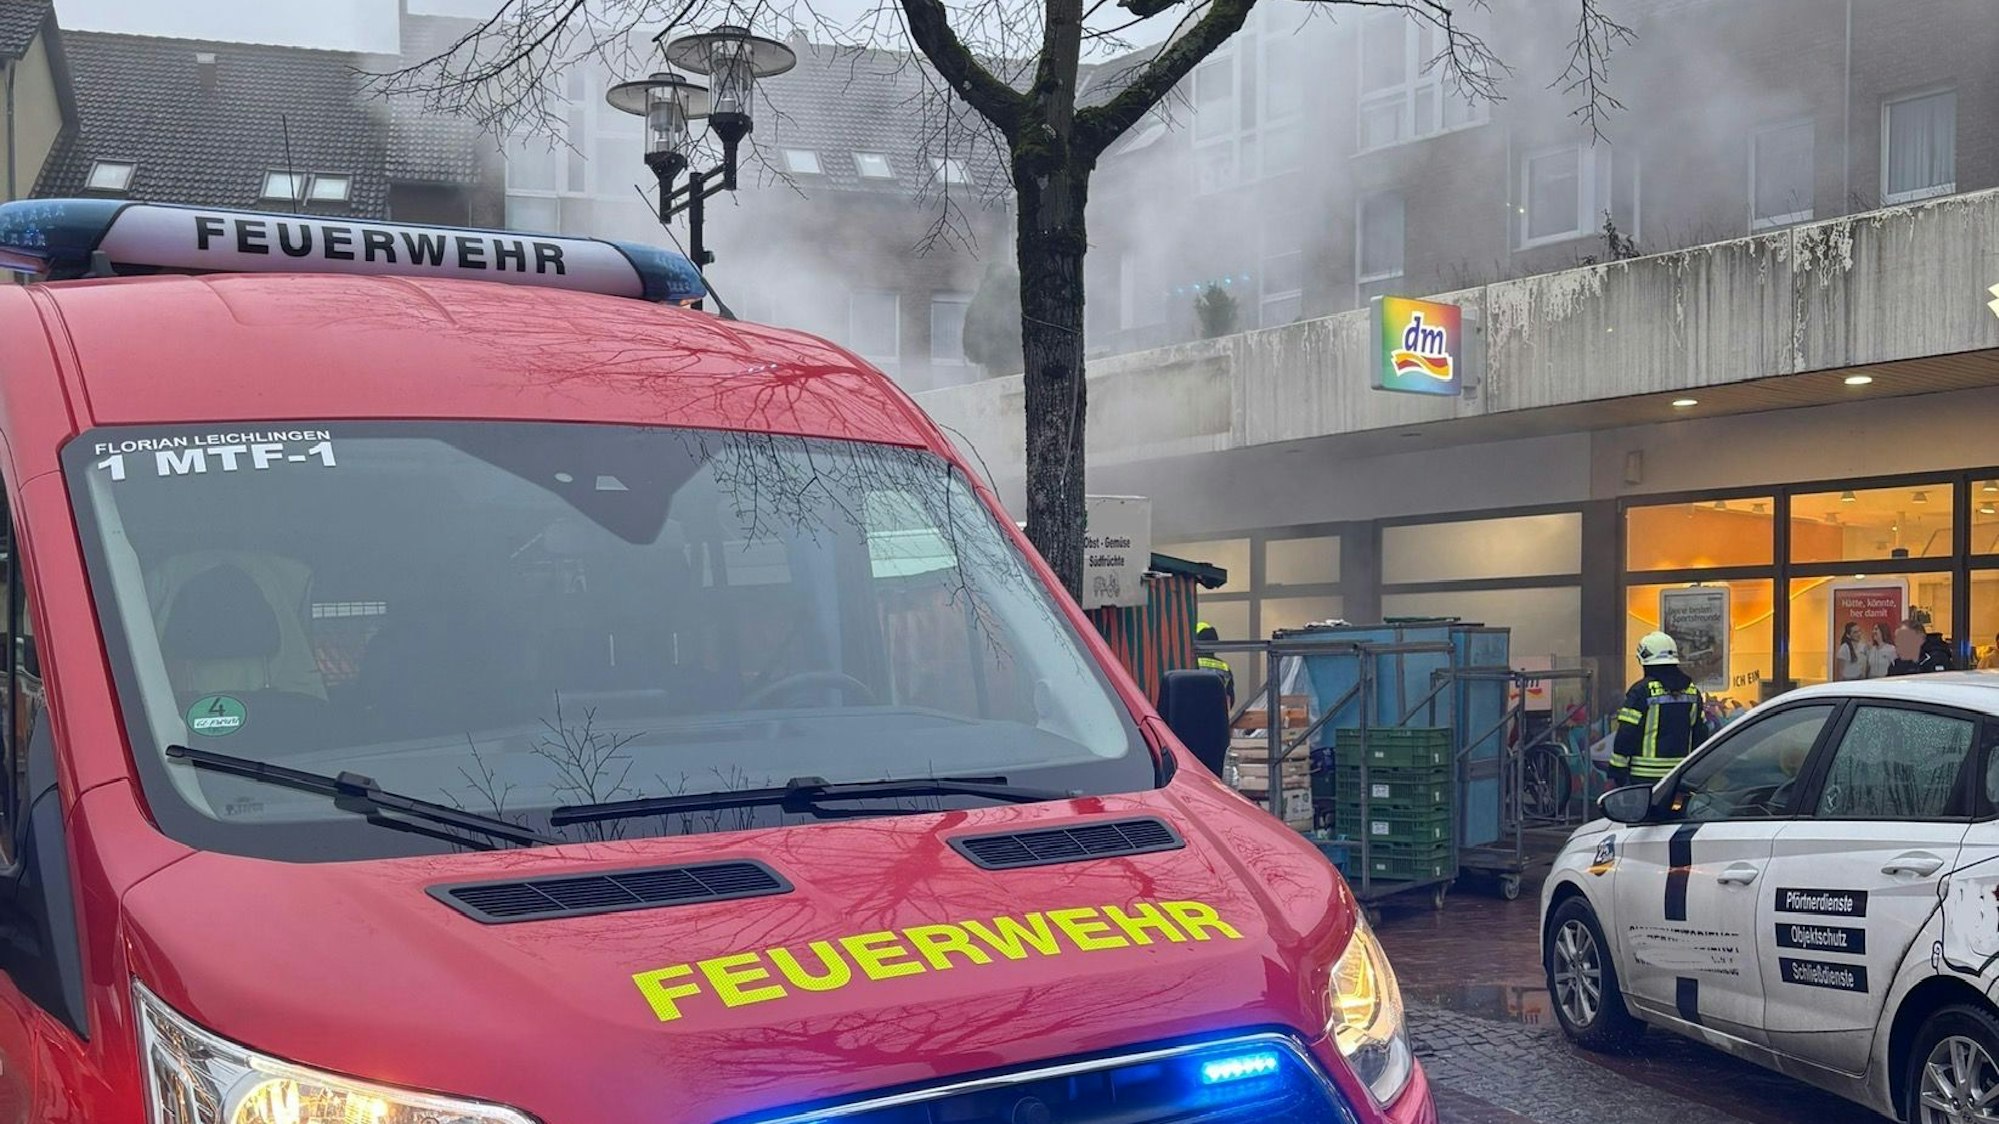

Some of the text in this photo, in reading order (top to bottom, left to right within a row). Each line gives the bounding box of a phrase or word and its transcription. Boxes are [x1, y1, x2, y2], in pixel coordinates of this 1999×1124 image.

[195, 216, 566, 275] FEUERWEHR
[1404, 315, 1444, 355] dm
[95, 430, 332, 455] FLORIAN LEICHLINGEN
[98, 441, 337, 481] 1 MTF-1
[1084, 536, 1099, 548] Obst
[1105, 536, 1130, 548] Gemüse
[1090, 555, 1125, 567] Südfrüchte
[1850, 608, 1888, 617] her damit
[1733, 669, 1760, 688] ICH EIN
[208, 696, 226, 717] 4
[1785, 891, 1854, 912] Pförtnerdienste
[1790, 925, 1848, 948] Objektschutz
[632, 901, 1244, 1022] FEUERWEHR
[1791, 961, 1855, 987] Schließdienste
